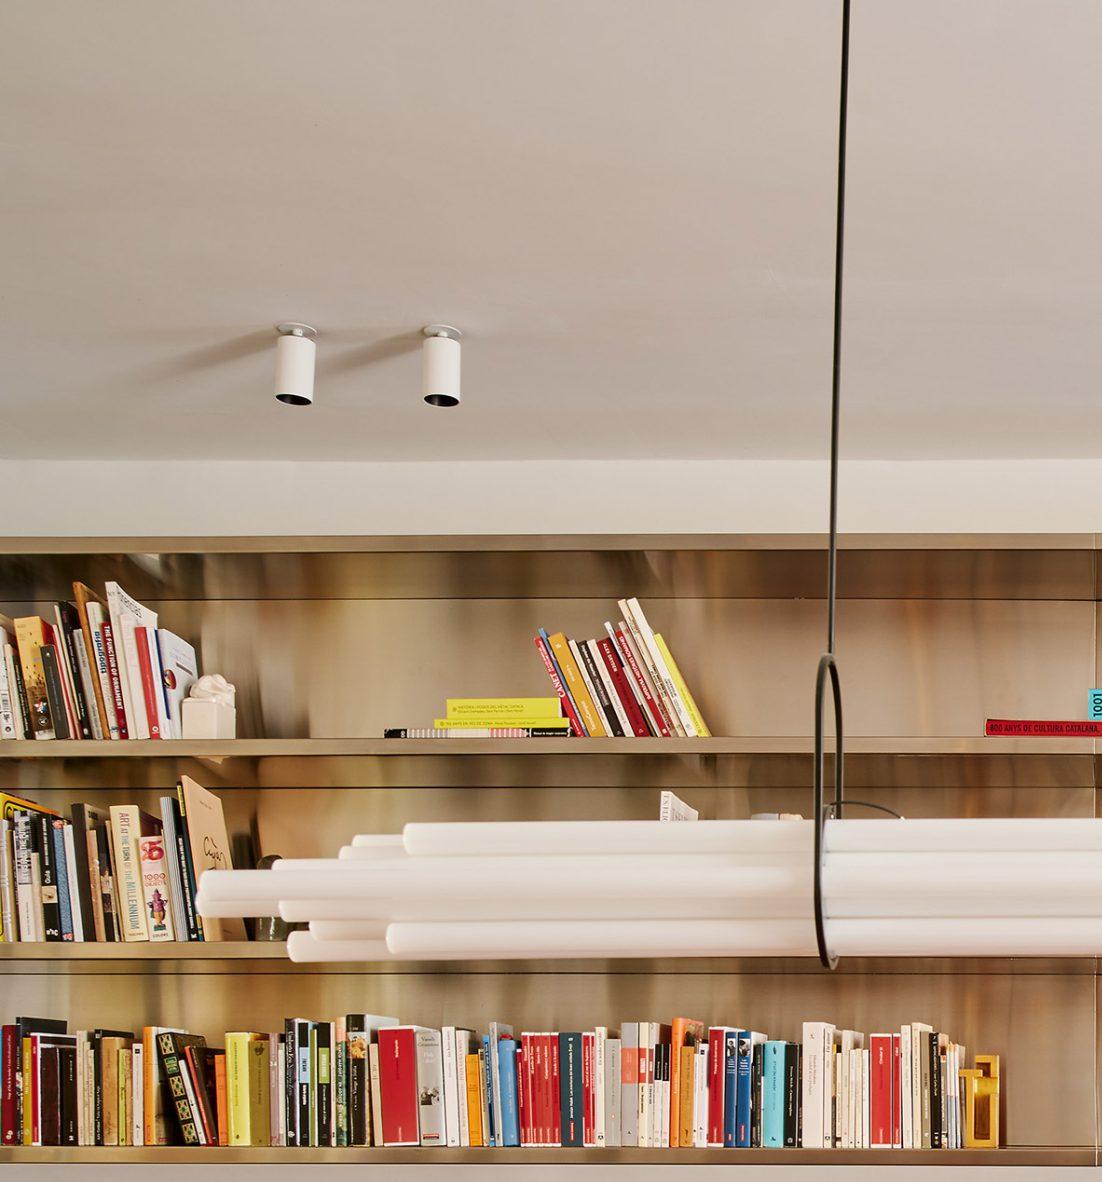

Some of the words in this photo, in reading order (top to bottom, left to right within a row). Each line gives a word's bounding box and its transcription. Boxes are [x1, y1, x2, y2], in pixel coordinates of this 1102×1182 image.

[103, 624, 111, 638] THE
[105, 637, 116, 667] FUNCTION
[111, 675, 123, 710] ORNAMENT
[1093, 693, 1102, 718] 1001
[1023, 724, 1034, 734] DE
[1034, 724, 1064, 734] CULTURA
[117, 811, 129, 827] ART
[124, 880, 140, 930] MILLENNIUM
[143, 872, 166, 881] 1000
